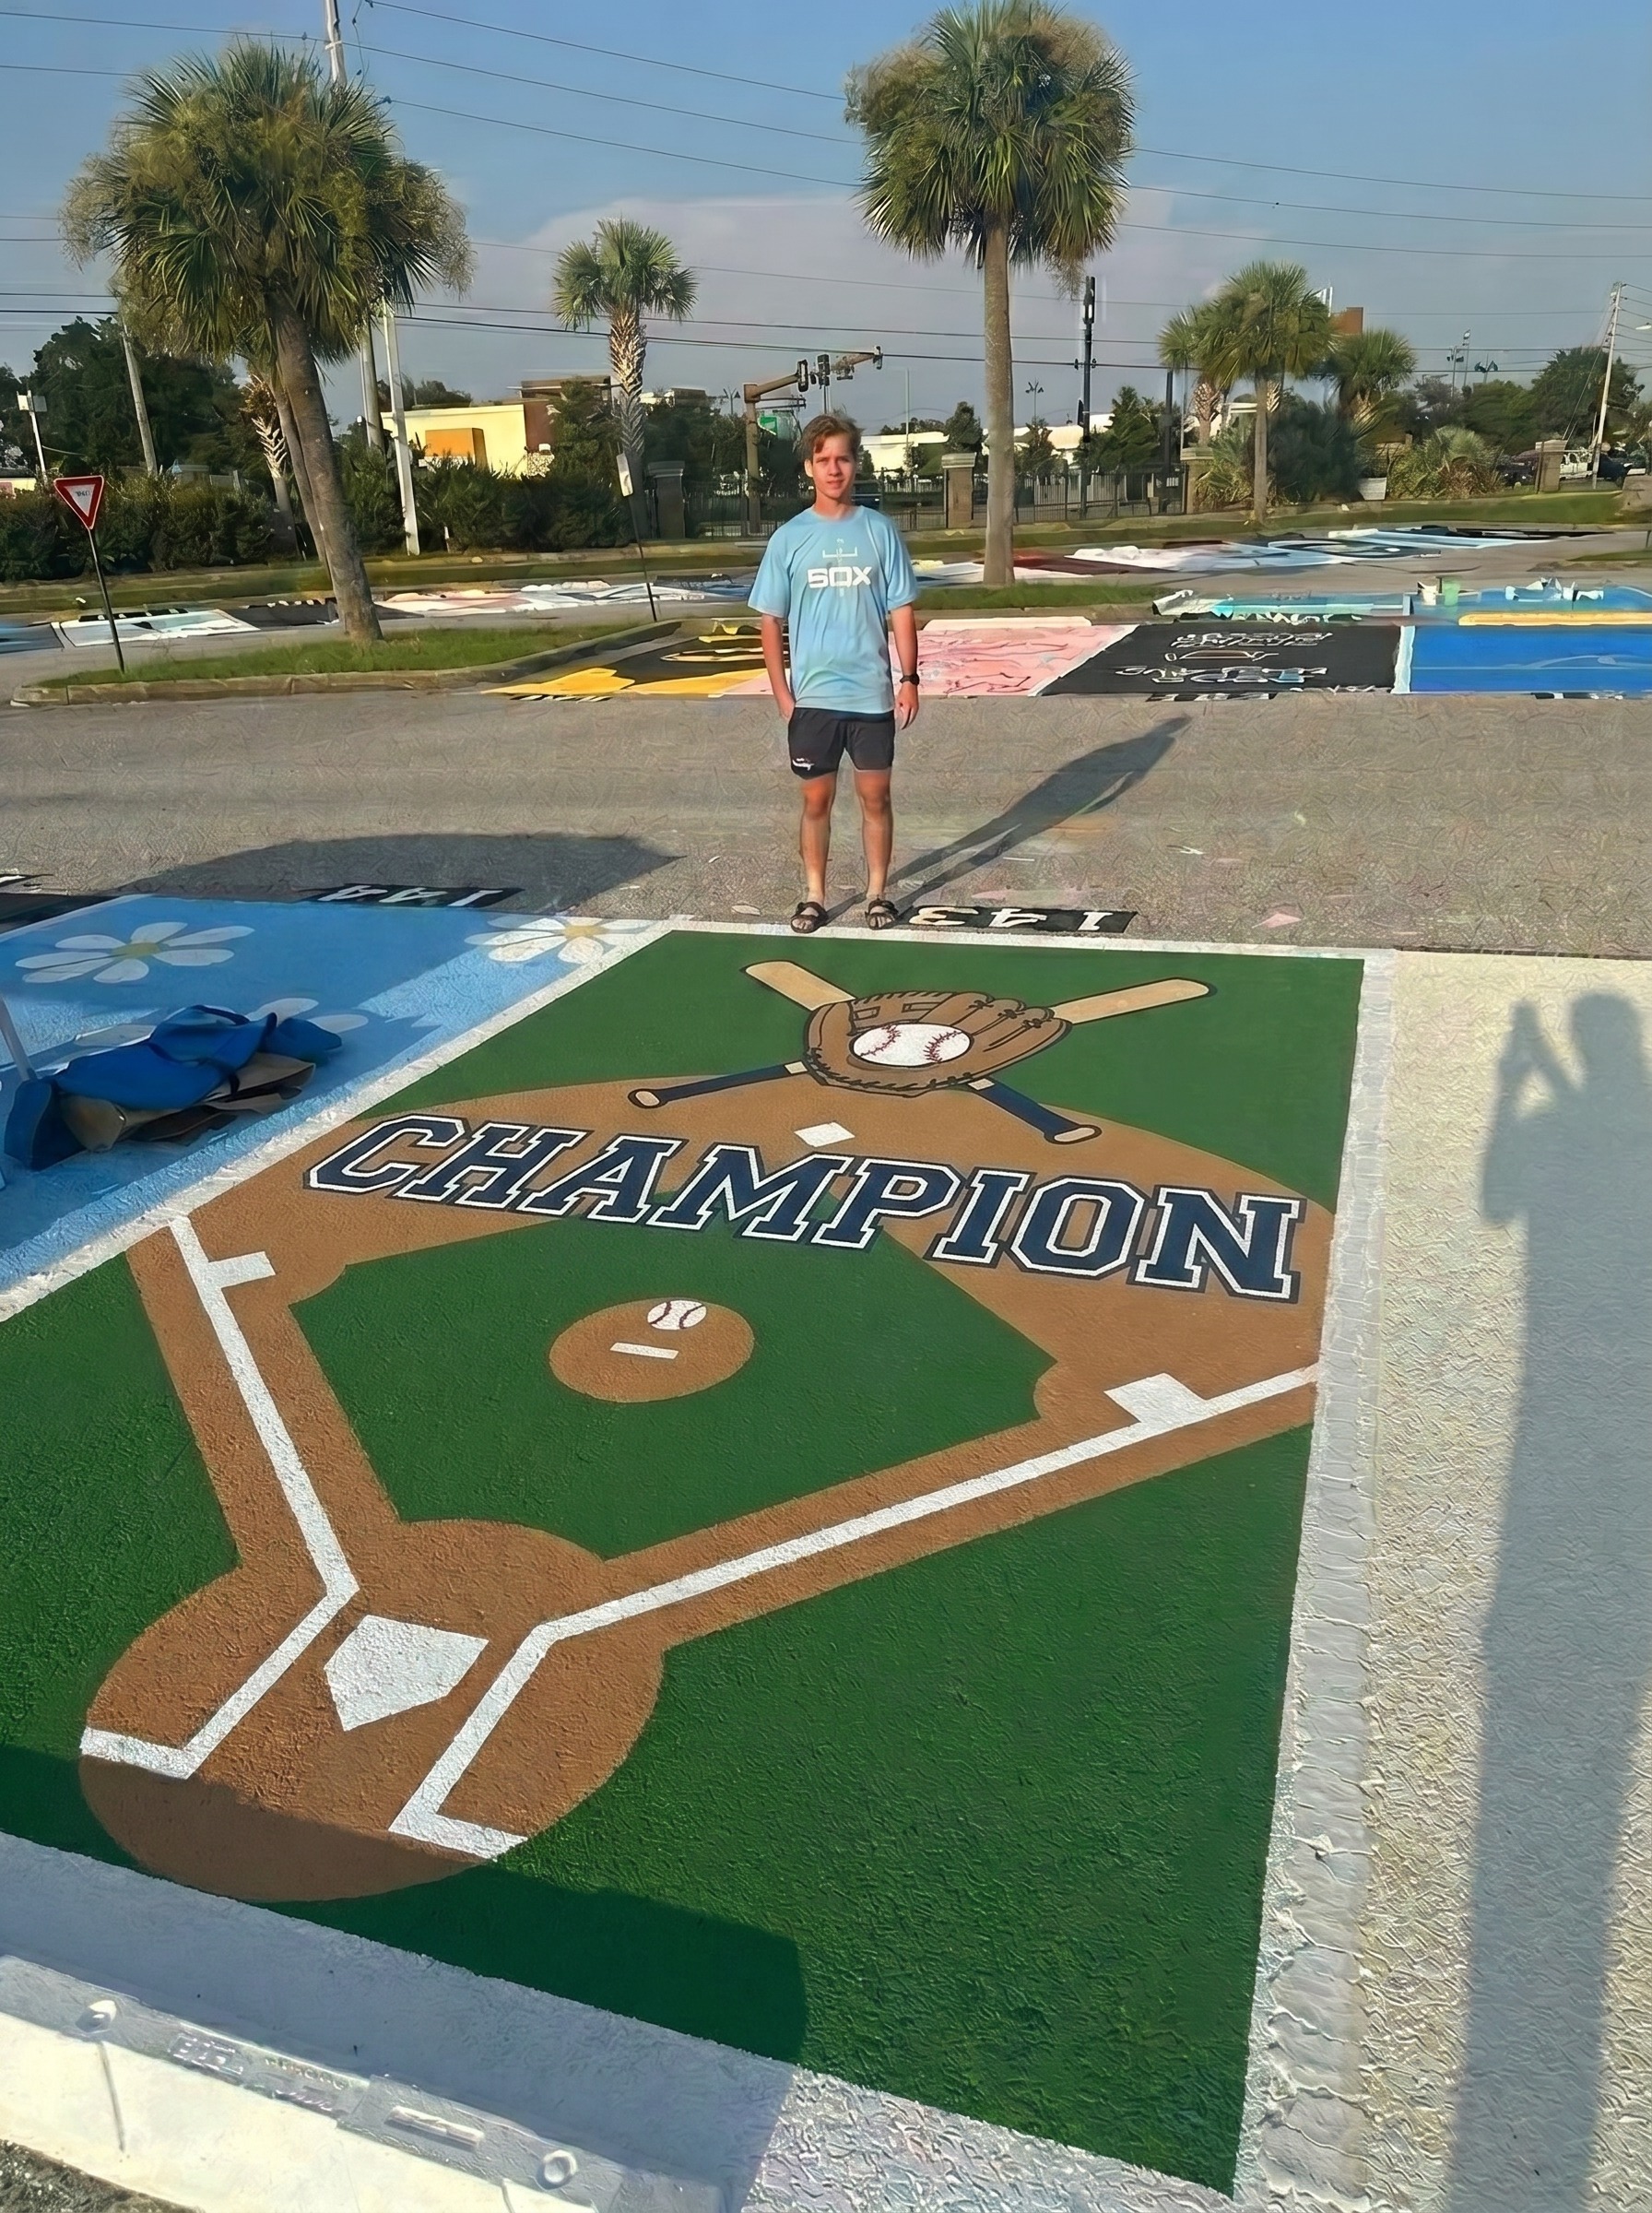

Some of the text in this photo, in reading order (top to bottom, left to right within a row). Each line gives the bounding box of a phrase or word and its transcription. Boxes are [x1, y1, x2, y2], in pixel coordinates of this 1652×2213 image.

[807, 566, 873, 588] SOX
[317, 884, 504, 907] 144
[908, 906, 1114, 931] 143
[304, 1113, 1305, 1303] CHAMPION
